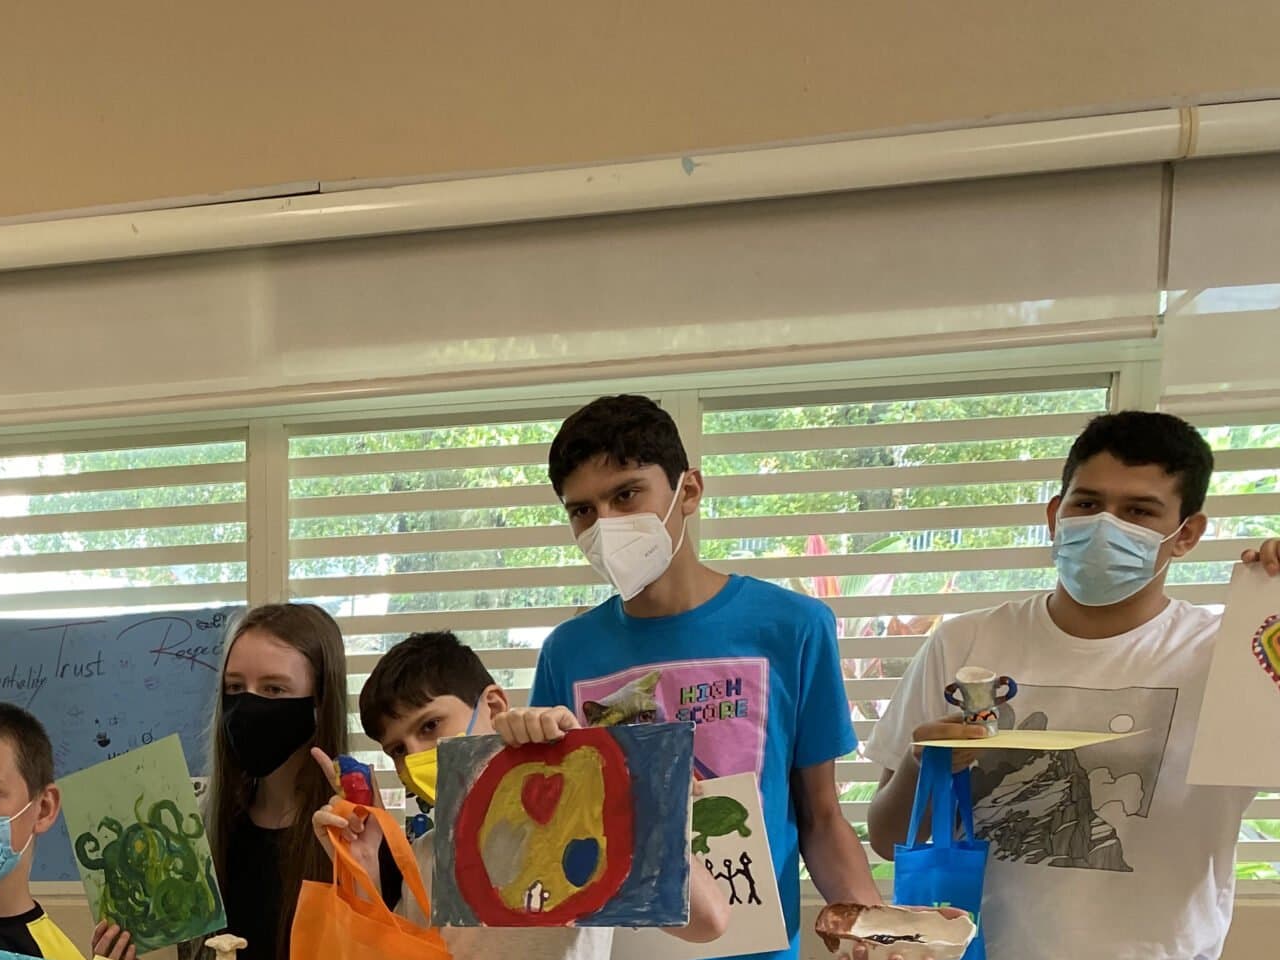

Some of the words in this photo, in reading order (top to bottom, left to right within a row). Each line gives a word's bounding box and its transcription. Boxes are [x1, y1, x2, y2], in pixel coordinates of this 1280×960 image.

[28, 620, 108, 678] Trust
[680, 677, 743, 705] HIGH
[676, 698, 749, 724] SCORE
